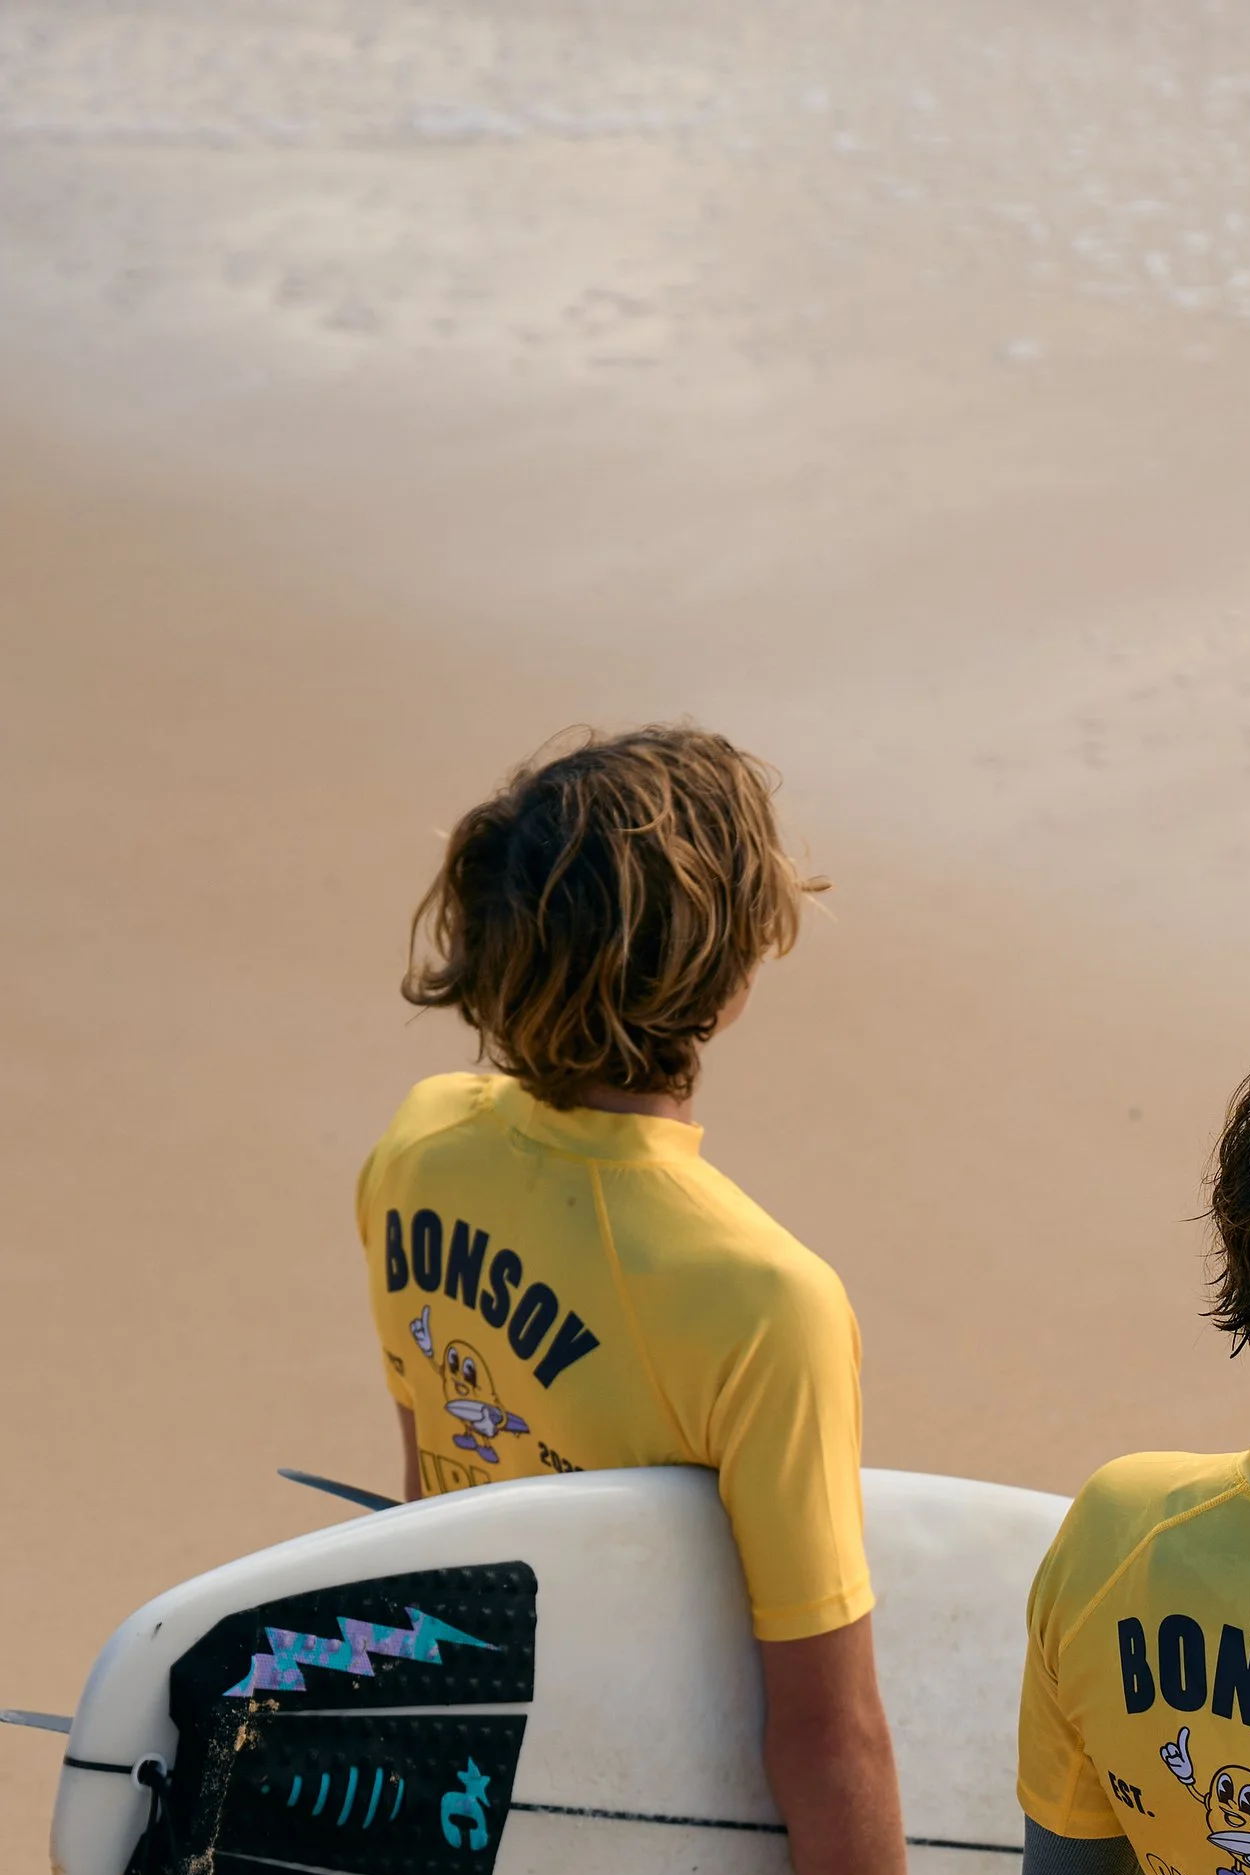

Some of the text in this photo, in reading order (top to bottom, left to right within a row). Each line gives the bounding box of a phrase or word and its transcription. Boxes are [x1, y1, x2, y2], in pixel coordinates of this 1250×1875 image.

[386, 1208, 601, 1390] BONSOY
[537, 1440, 584, 1473] 202
[1107, 1769, 1156, 1818] EST.
